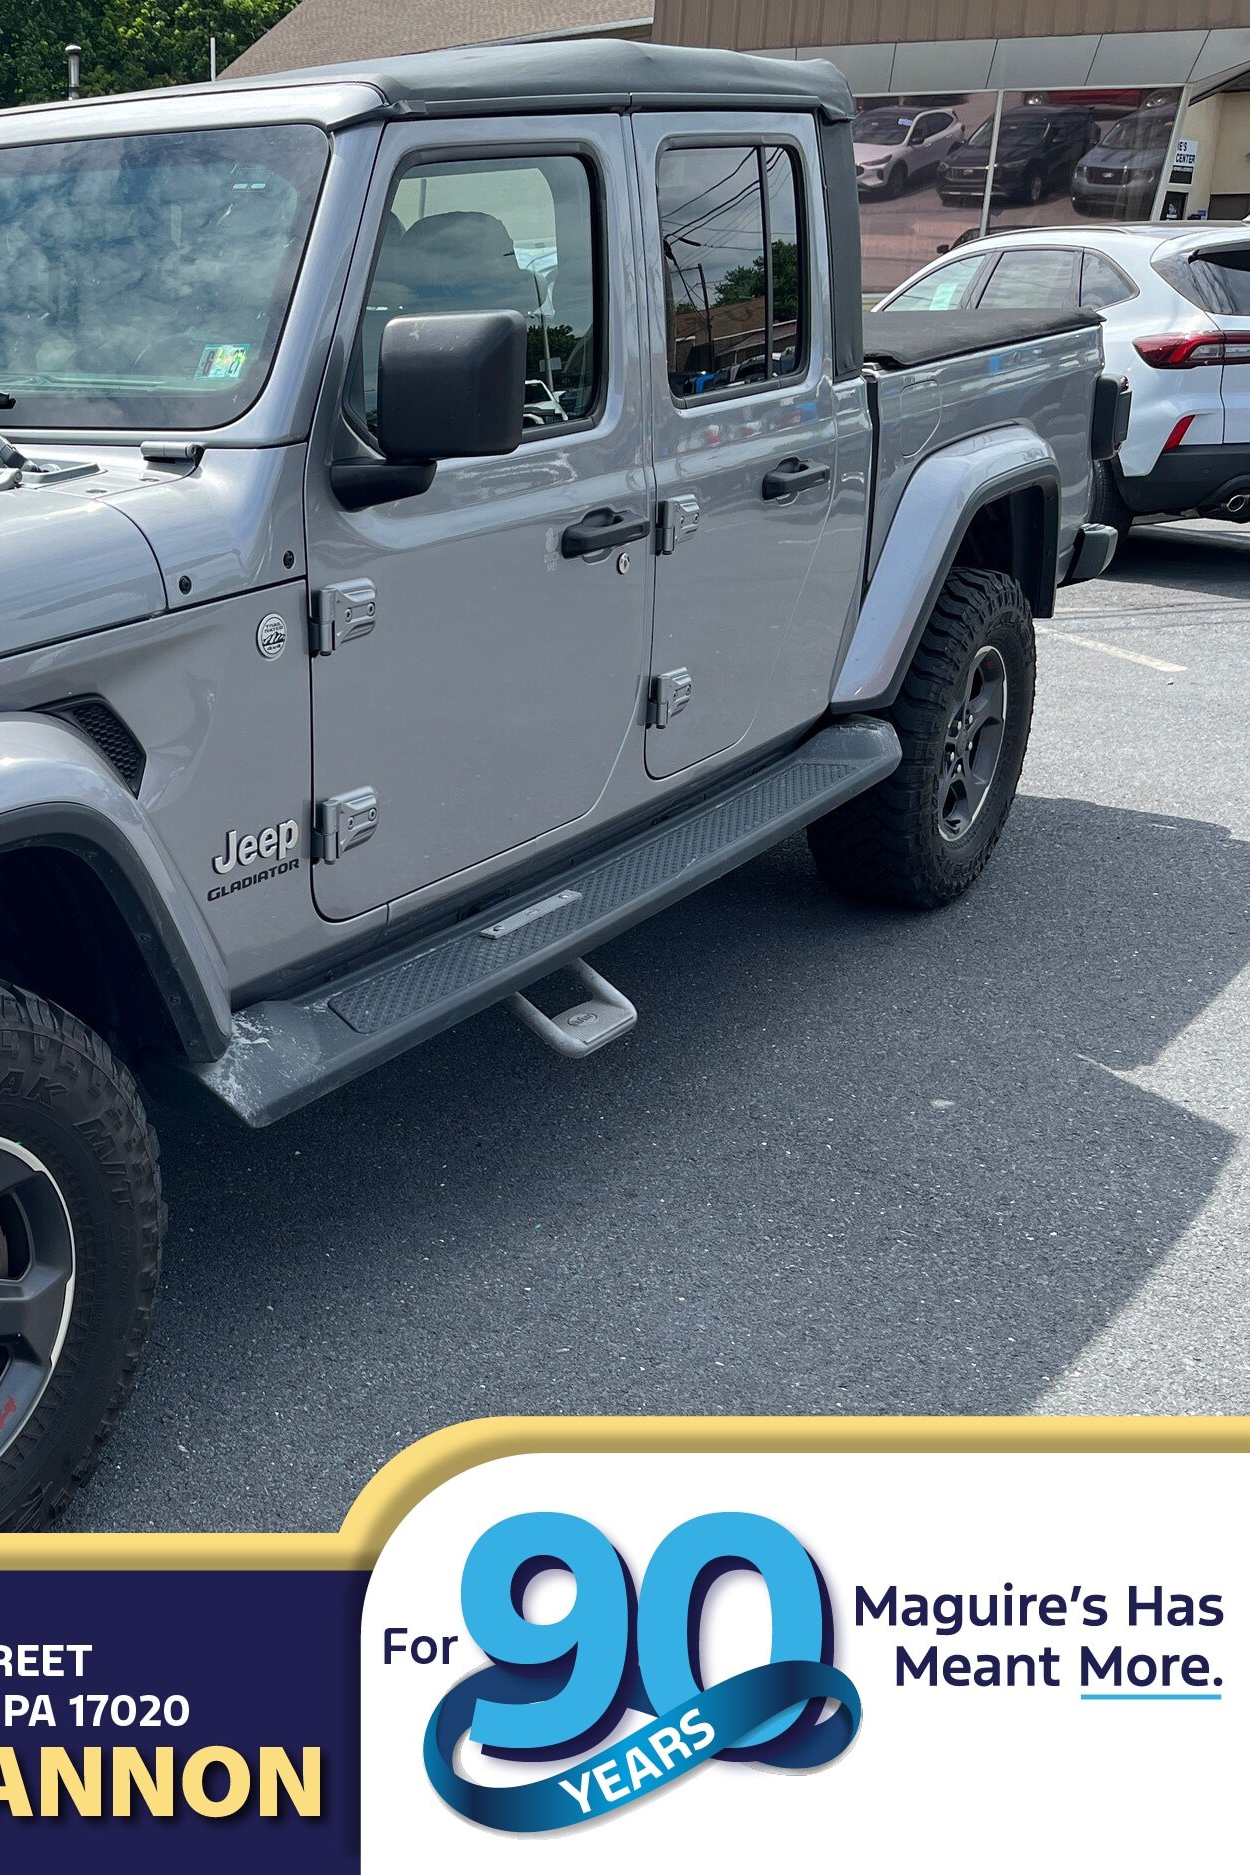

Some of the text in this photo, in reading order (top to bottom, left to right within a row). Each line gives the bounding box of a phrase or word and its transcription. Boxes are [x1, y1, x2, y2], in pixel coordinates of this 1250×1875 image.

[1176, 153, 1195, 163] CENTER
[212, 819, 299, 875] Jeep
[206, 858, 300, 902] GLADIATOR
